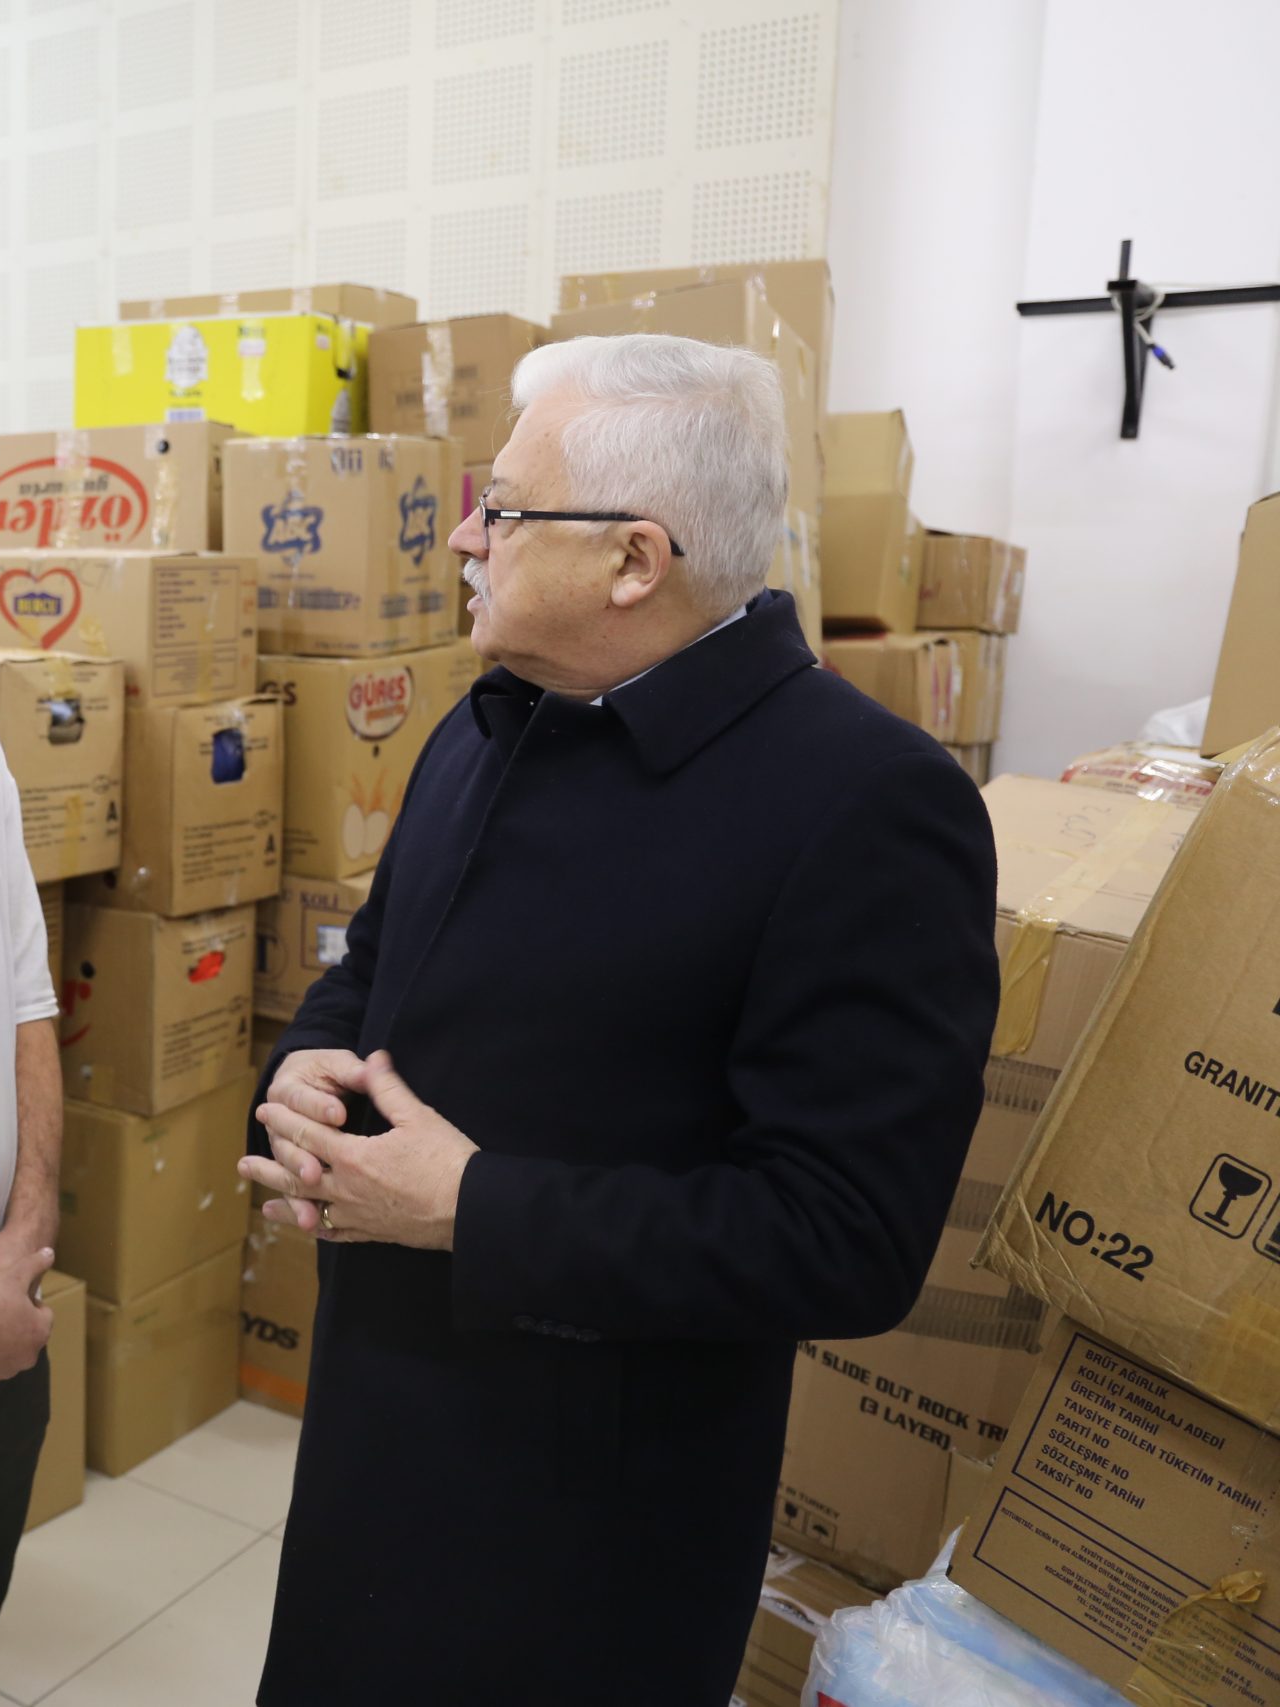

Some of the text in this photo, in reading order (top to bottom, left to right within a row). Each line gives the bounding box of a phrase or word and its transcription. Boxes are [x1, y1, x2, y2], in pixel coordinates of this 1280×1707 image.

[1035, 1191, 1154, 1282] NO:22
[821, 1350, 872, 1386] SLIDE
[875, 1376, 914, 1403] OUT
[917, 1394, 970, 1430] ROCK
[1085, 1349, 1169, 1400] BRÜT AĞIRLIK
[883, 1406, 952, 1451] LAYER)
[1125, 1391, 1185, 1428] AMBALAJ
[1041, 1444, 1103, 1486] SÖZLEŞME
[1048, 1428, 1130, 1481] SÖZLEŞME NO
[1063, 1396, 1112, 1430] TAVSİYE
[1112, 1424, 1157, 1456] EDİLEN
[1158, 1448, 1214, 1487] TÜKETİM
[1092, 1433, 1110, 1449] NO
[1075, 1483, 1094, 1500] NO
